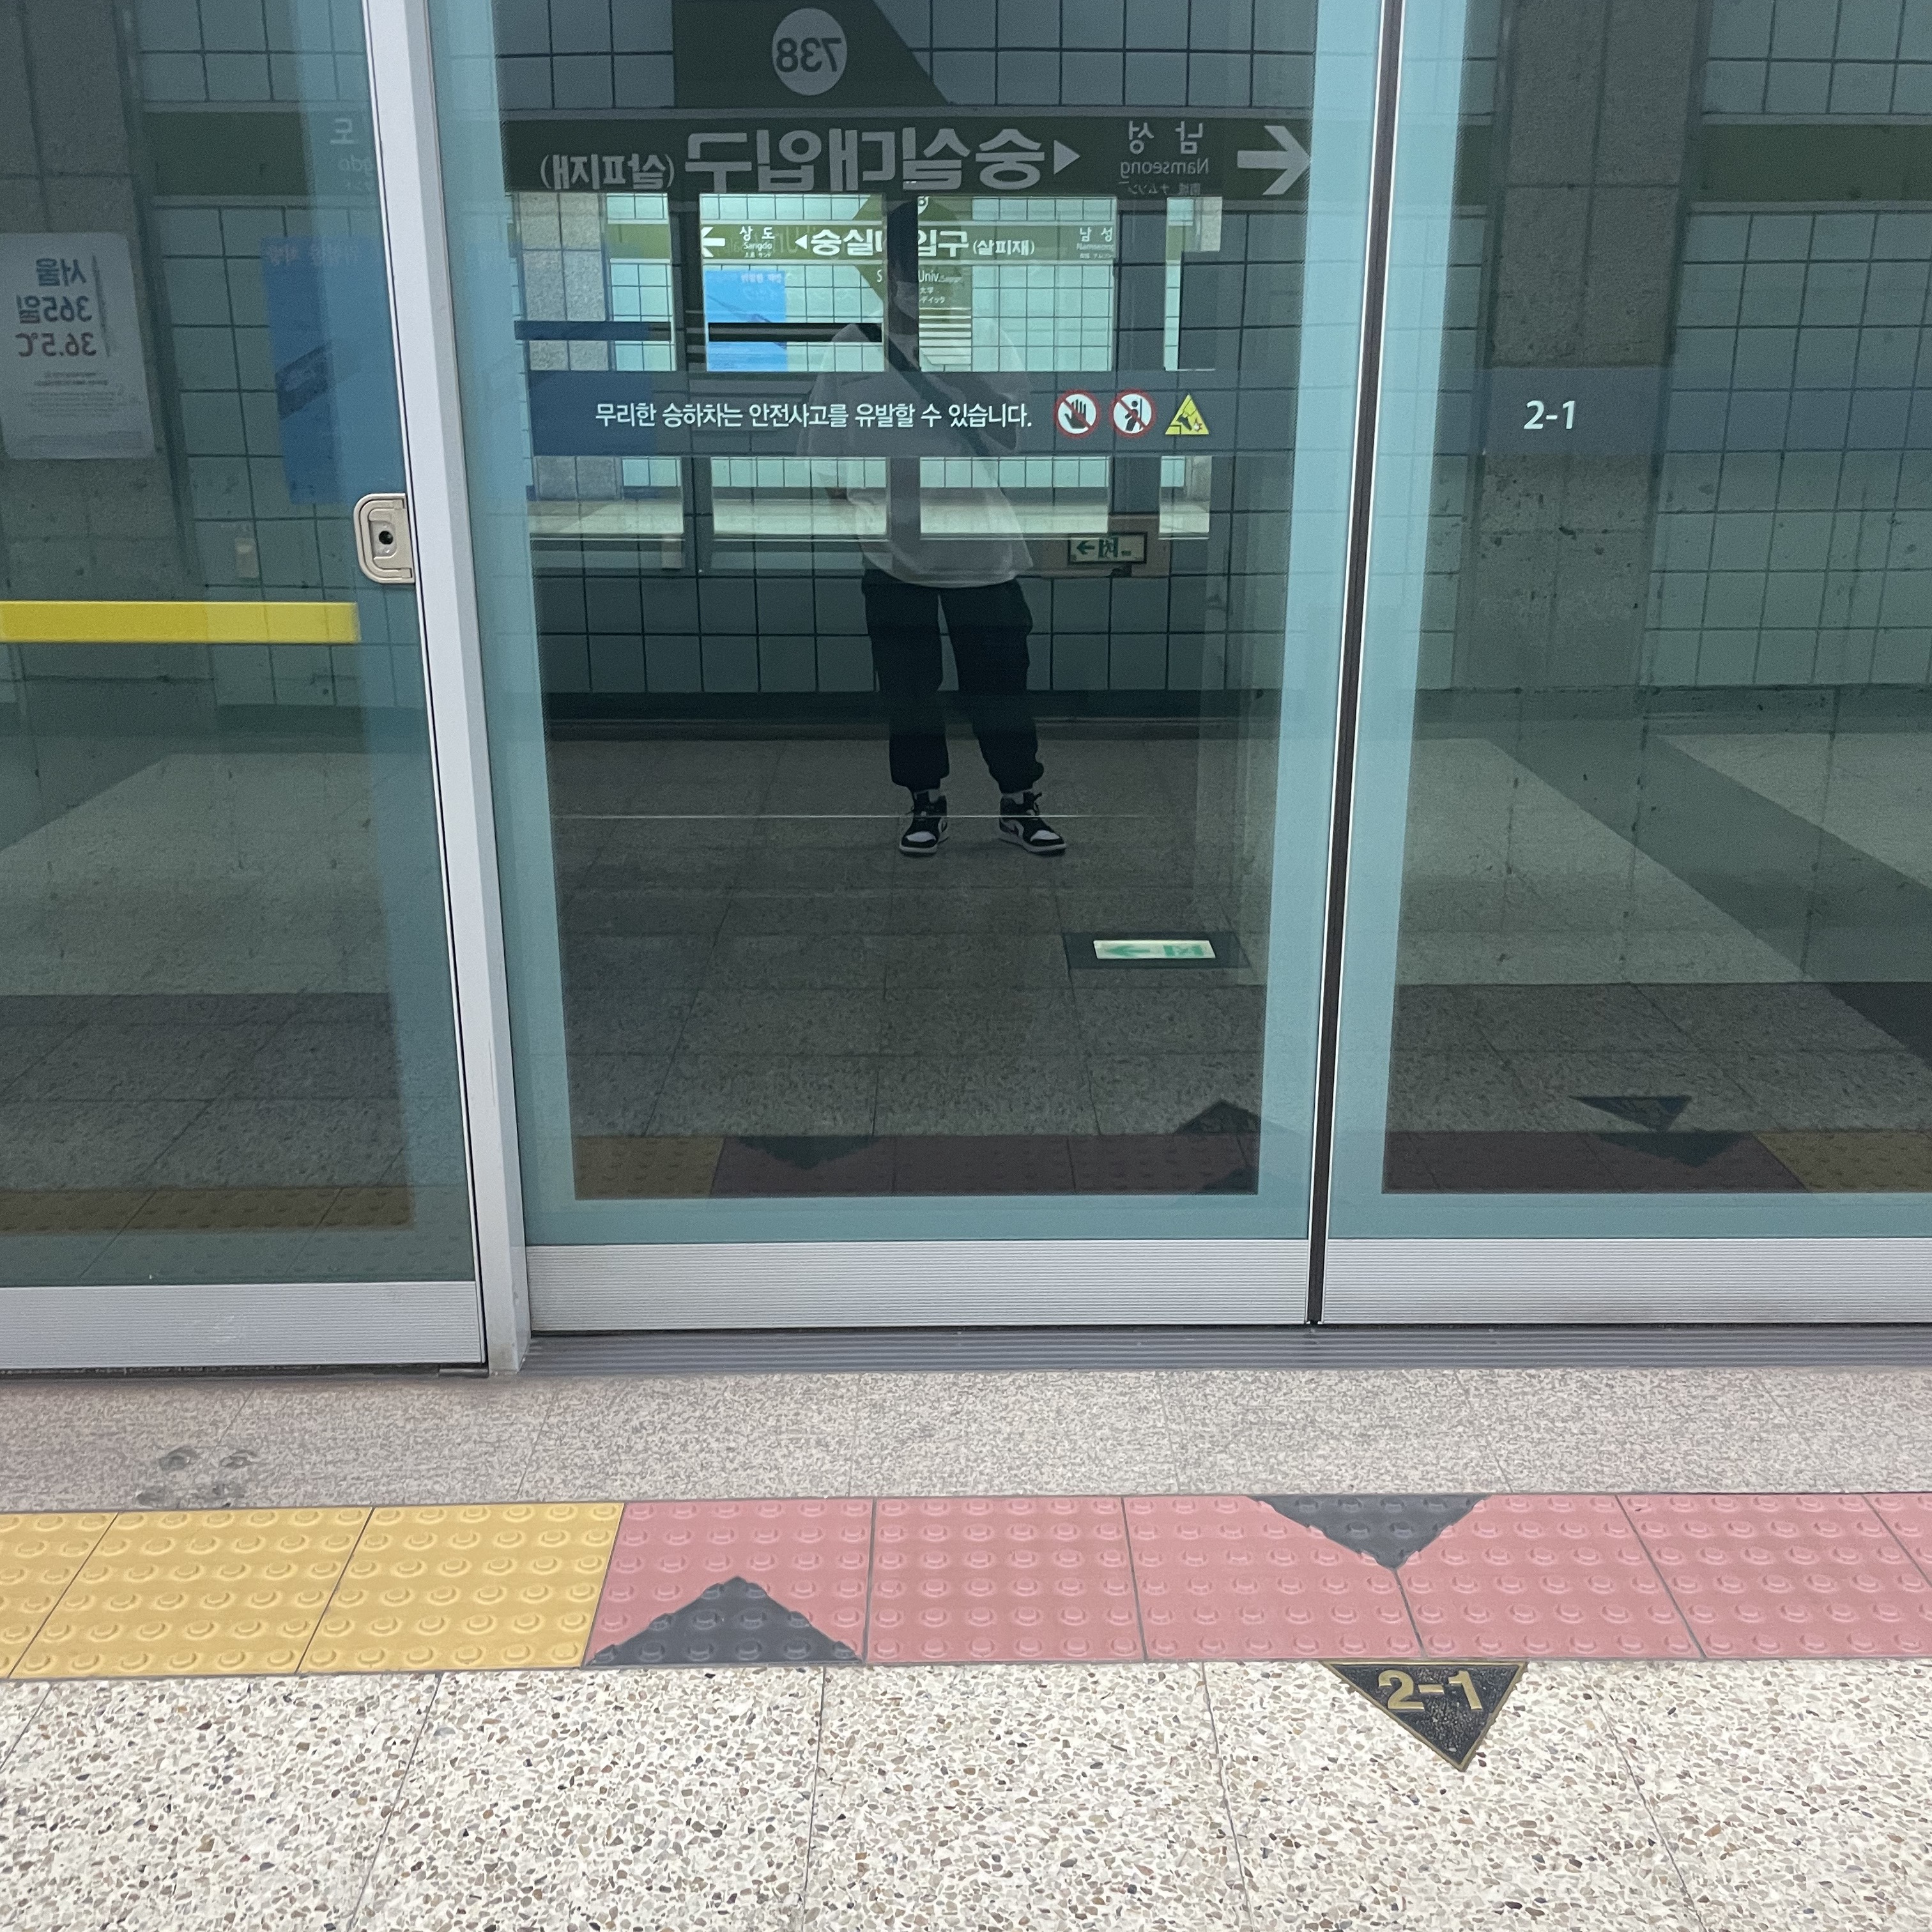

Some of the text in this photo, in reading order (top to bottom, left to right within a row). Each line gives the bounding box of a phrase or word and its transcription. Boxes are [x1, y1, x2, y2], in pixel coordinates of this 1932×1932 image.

[972, 239, 1035, 256] (살피재)
[595, 402, 1032, 428] 무리한 승하차는 안전사고를 유발할 수 있습니다.
[1523, 399, 1576, 431] 2-1
[1377, 1669, 1483, 1712] 2-1
